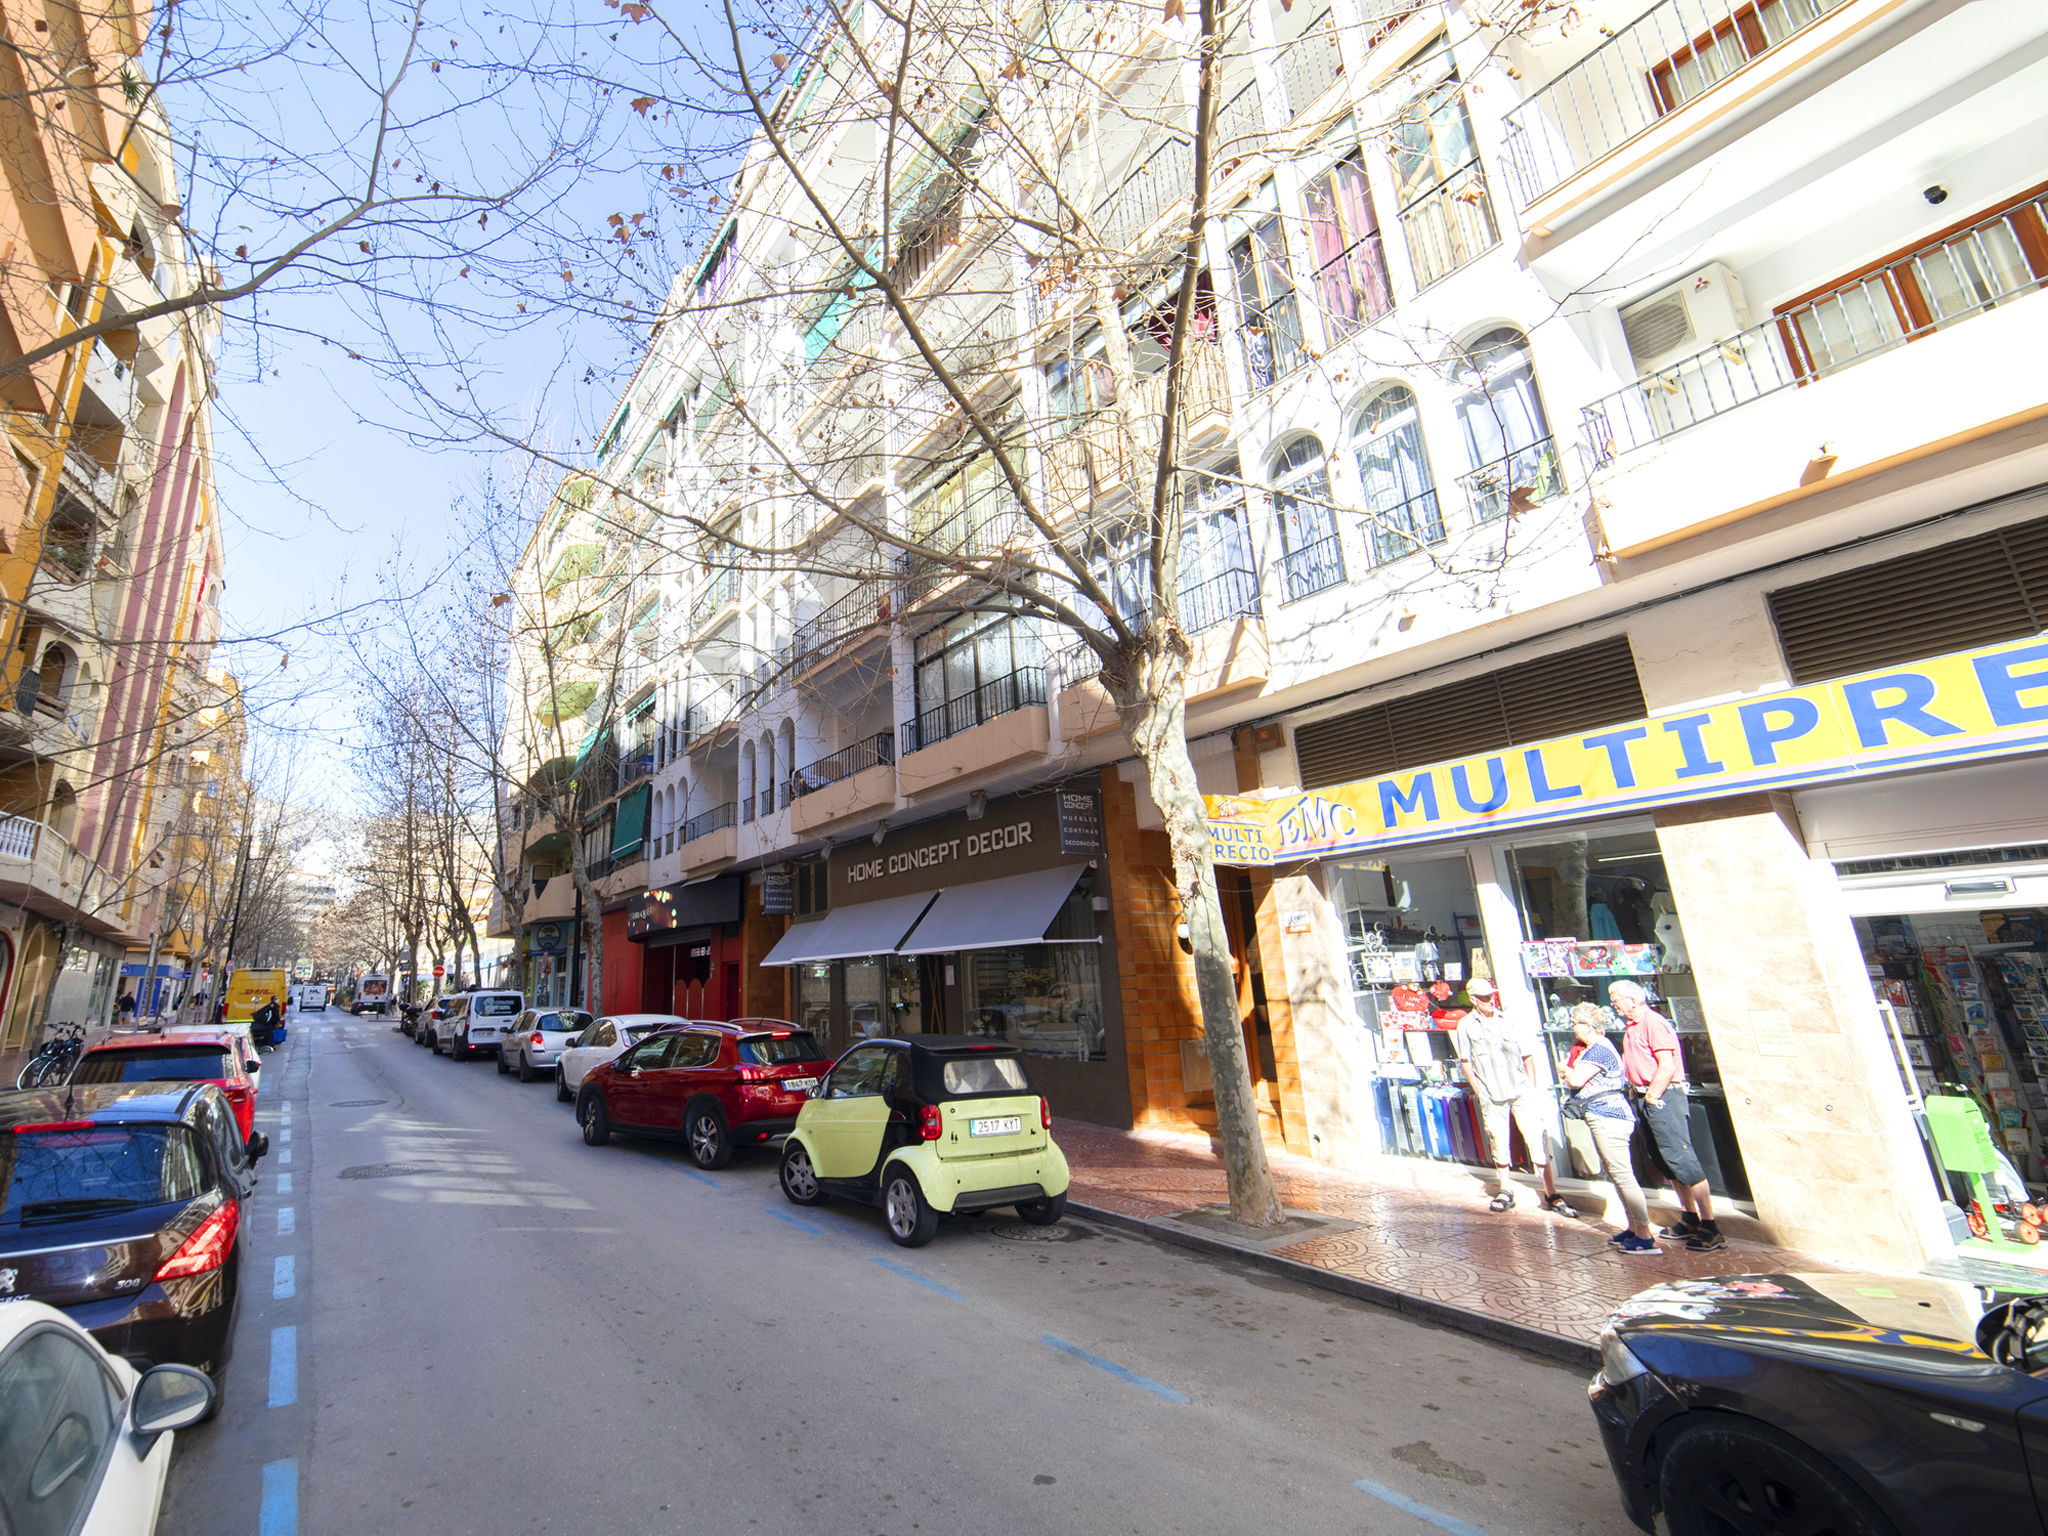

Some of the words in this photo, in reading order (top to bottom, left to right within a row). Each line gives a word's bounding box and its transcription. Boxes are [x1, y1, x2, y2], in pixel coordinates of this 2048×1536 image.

[1062, 793, 1094, 803] HOME
[1063, 801, 1095, 810] CONCEPT
[1277, 796, 1357, 847] EMC
[847, 859, 884, 883] HOME
[888, 840, 960, 875] CONCEPT
[967, 821, 1033, 857] DECOR
[1214, 844, 1271, 861] RECIO
[978, 1120, 1000, 1134] 2517
[1003, 1118, 1019, 1131] KYT
[114, 1278, 141, 1290] 308
